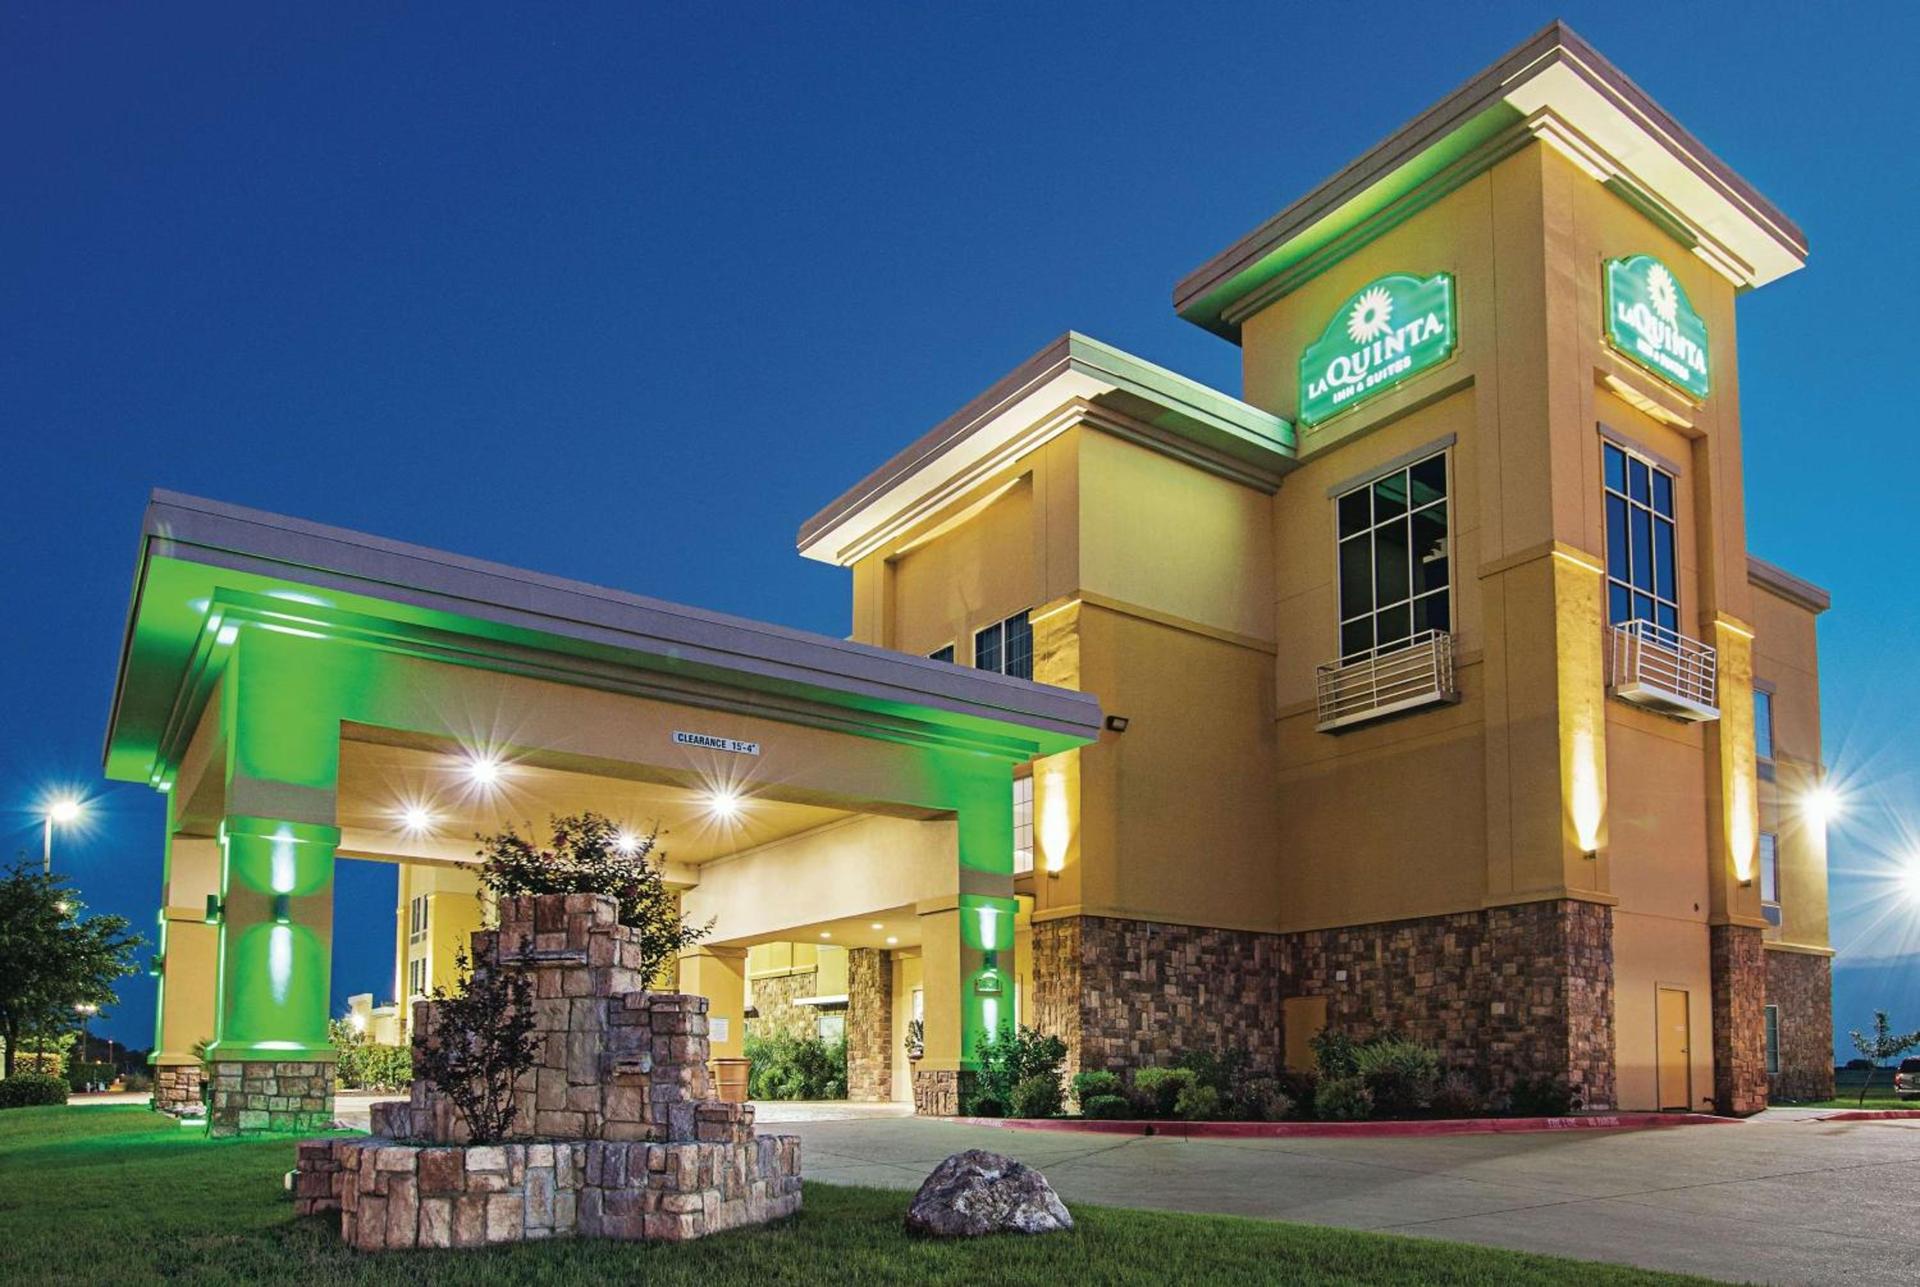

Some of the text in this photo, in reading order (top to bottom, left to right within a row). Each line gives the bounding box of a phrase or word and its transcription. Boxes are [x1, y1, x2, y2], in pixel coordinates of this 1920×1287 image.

[1308, 312, 1444, 400] LA QUINTA
[1632, 302, 1707, 375] QUINTA
[1332, 384, 1355, 404] INN
[1366, 355, 1412, 388] SUITES
[677, 733, 727, 748] CLEARANCE
